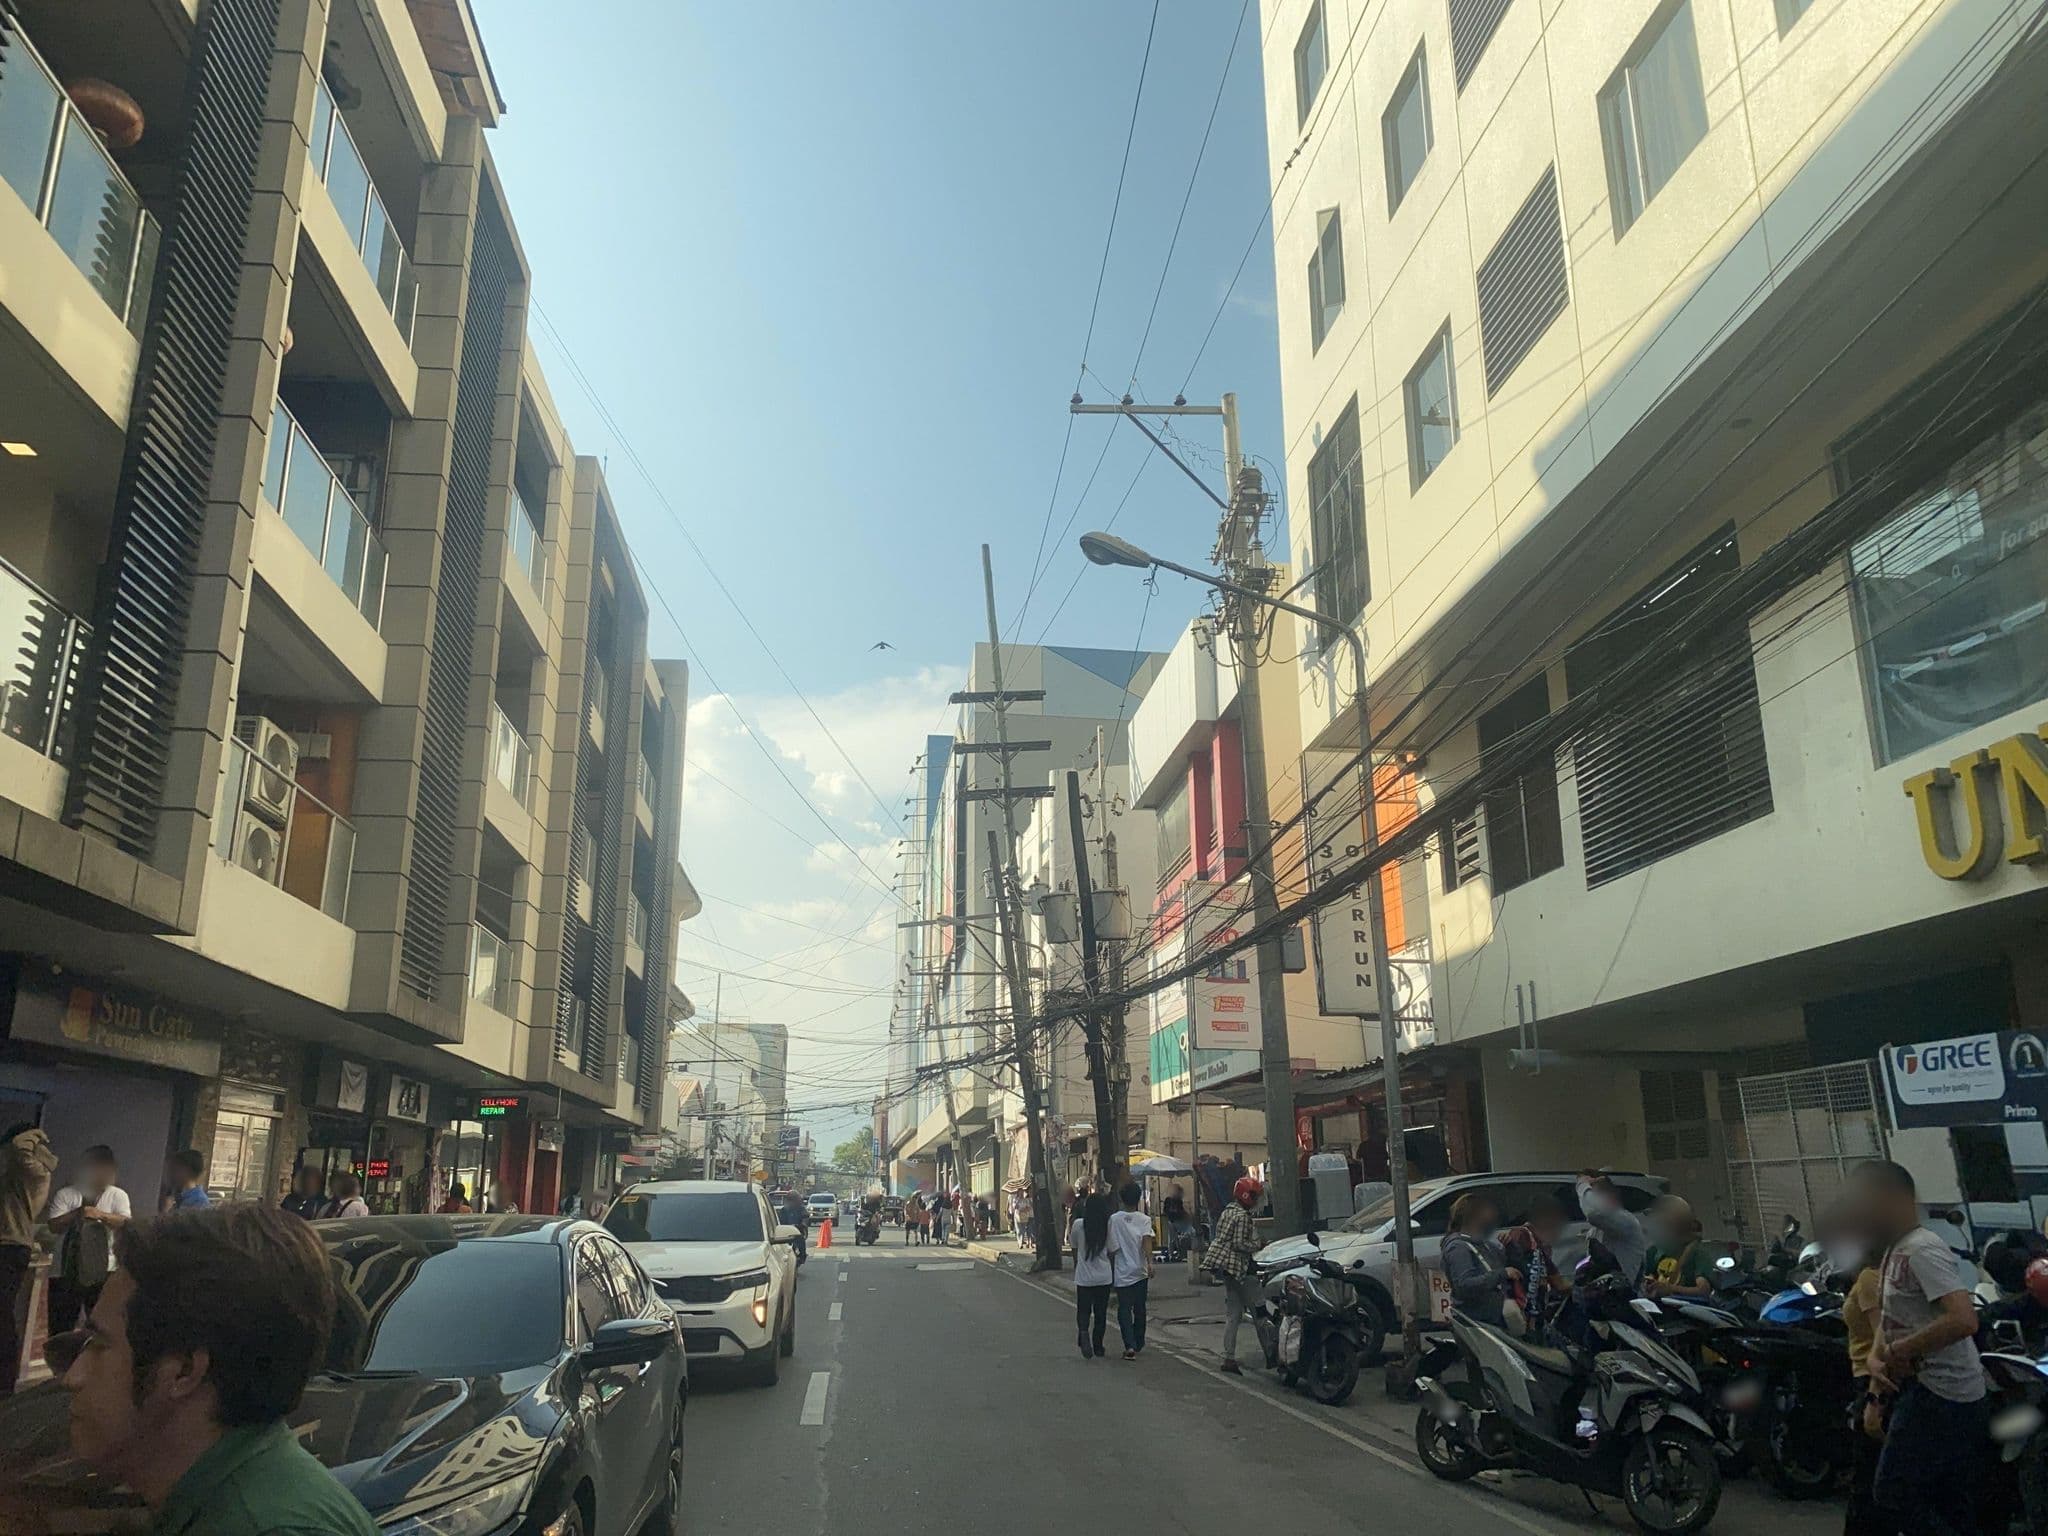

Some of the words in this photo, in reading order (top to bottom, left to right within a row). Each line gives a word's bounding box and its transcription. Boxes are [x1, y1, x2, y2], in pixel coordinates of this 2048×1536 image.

[1345, 844, 1372, 987] OERRUN
[98, 992, 142, 1030] Sun
[1922, 1040, 1991, 1072] GREE
[480, 1098, 519, 1106] CELLPHONE
[480, 1106, 505, 1115] REPAIR
[2004, 1104, 2037, 1118] Primo
